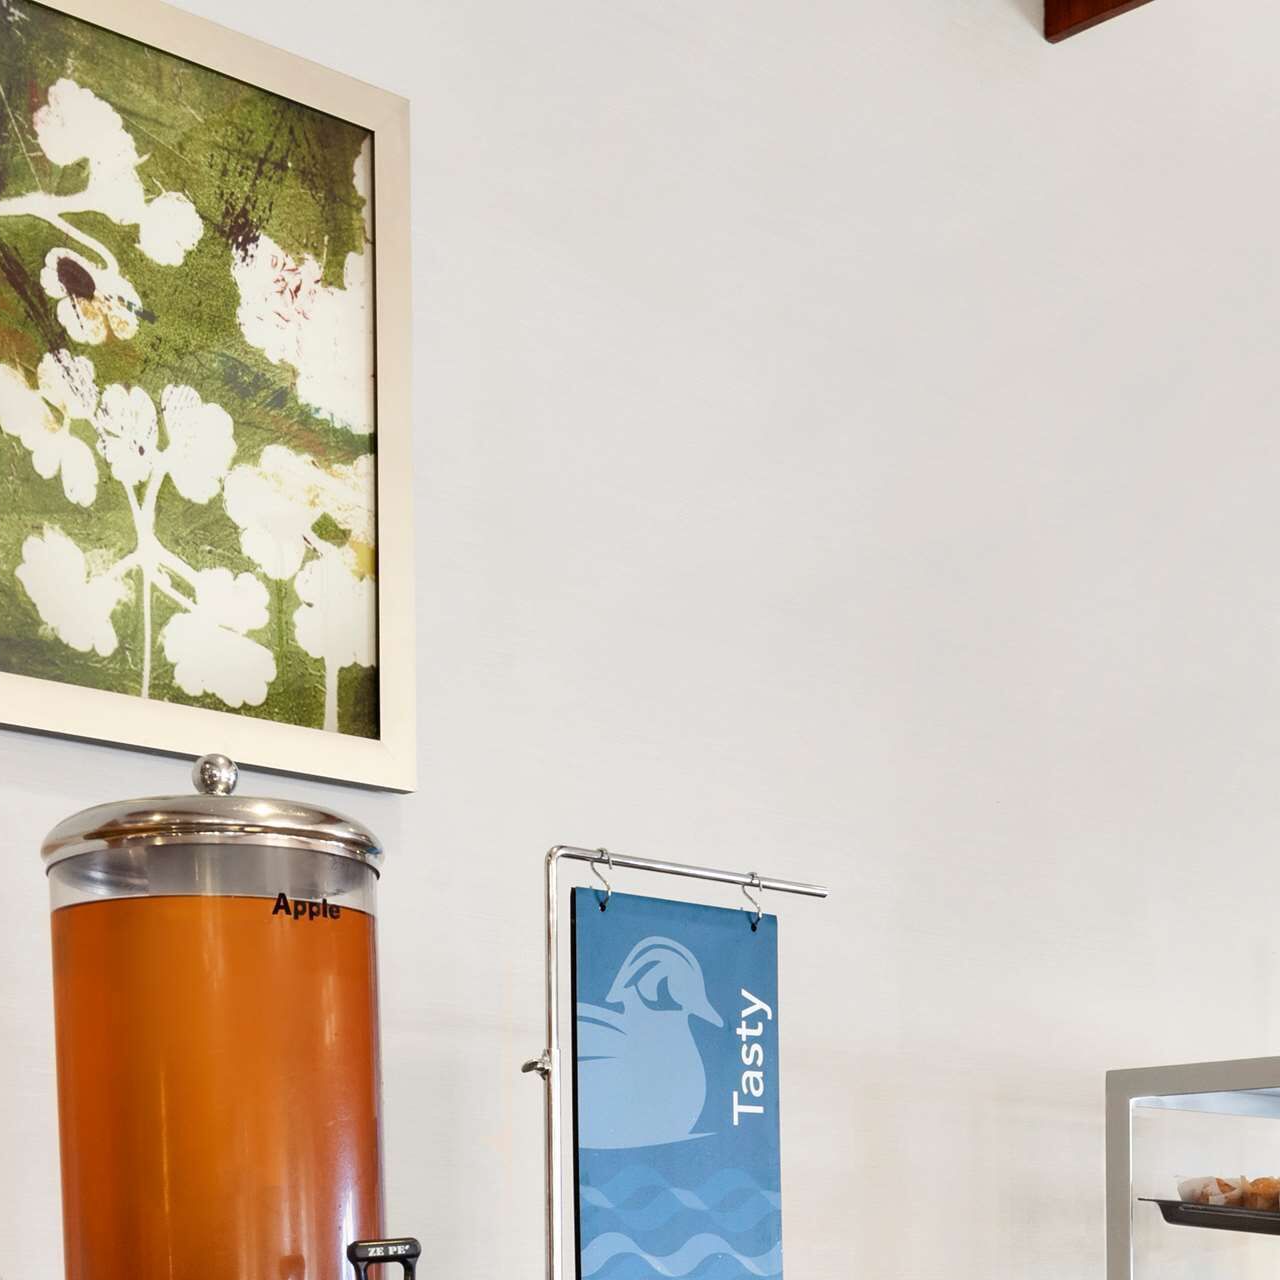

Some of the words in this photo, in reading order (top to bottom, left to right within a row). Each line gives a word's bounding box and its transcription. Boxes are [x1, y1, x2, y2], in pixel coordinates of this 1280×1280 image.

[272, 892, 341, 921] Apple
[733, 988, 772, 1126] Tasty
[367, 1247, 385, 1257] ZE
